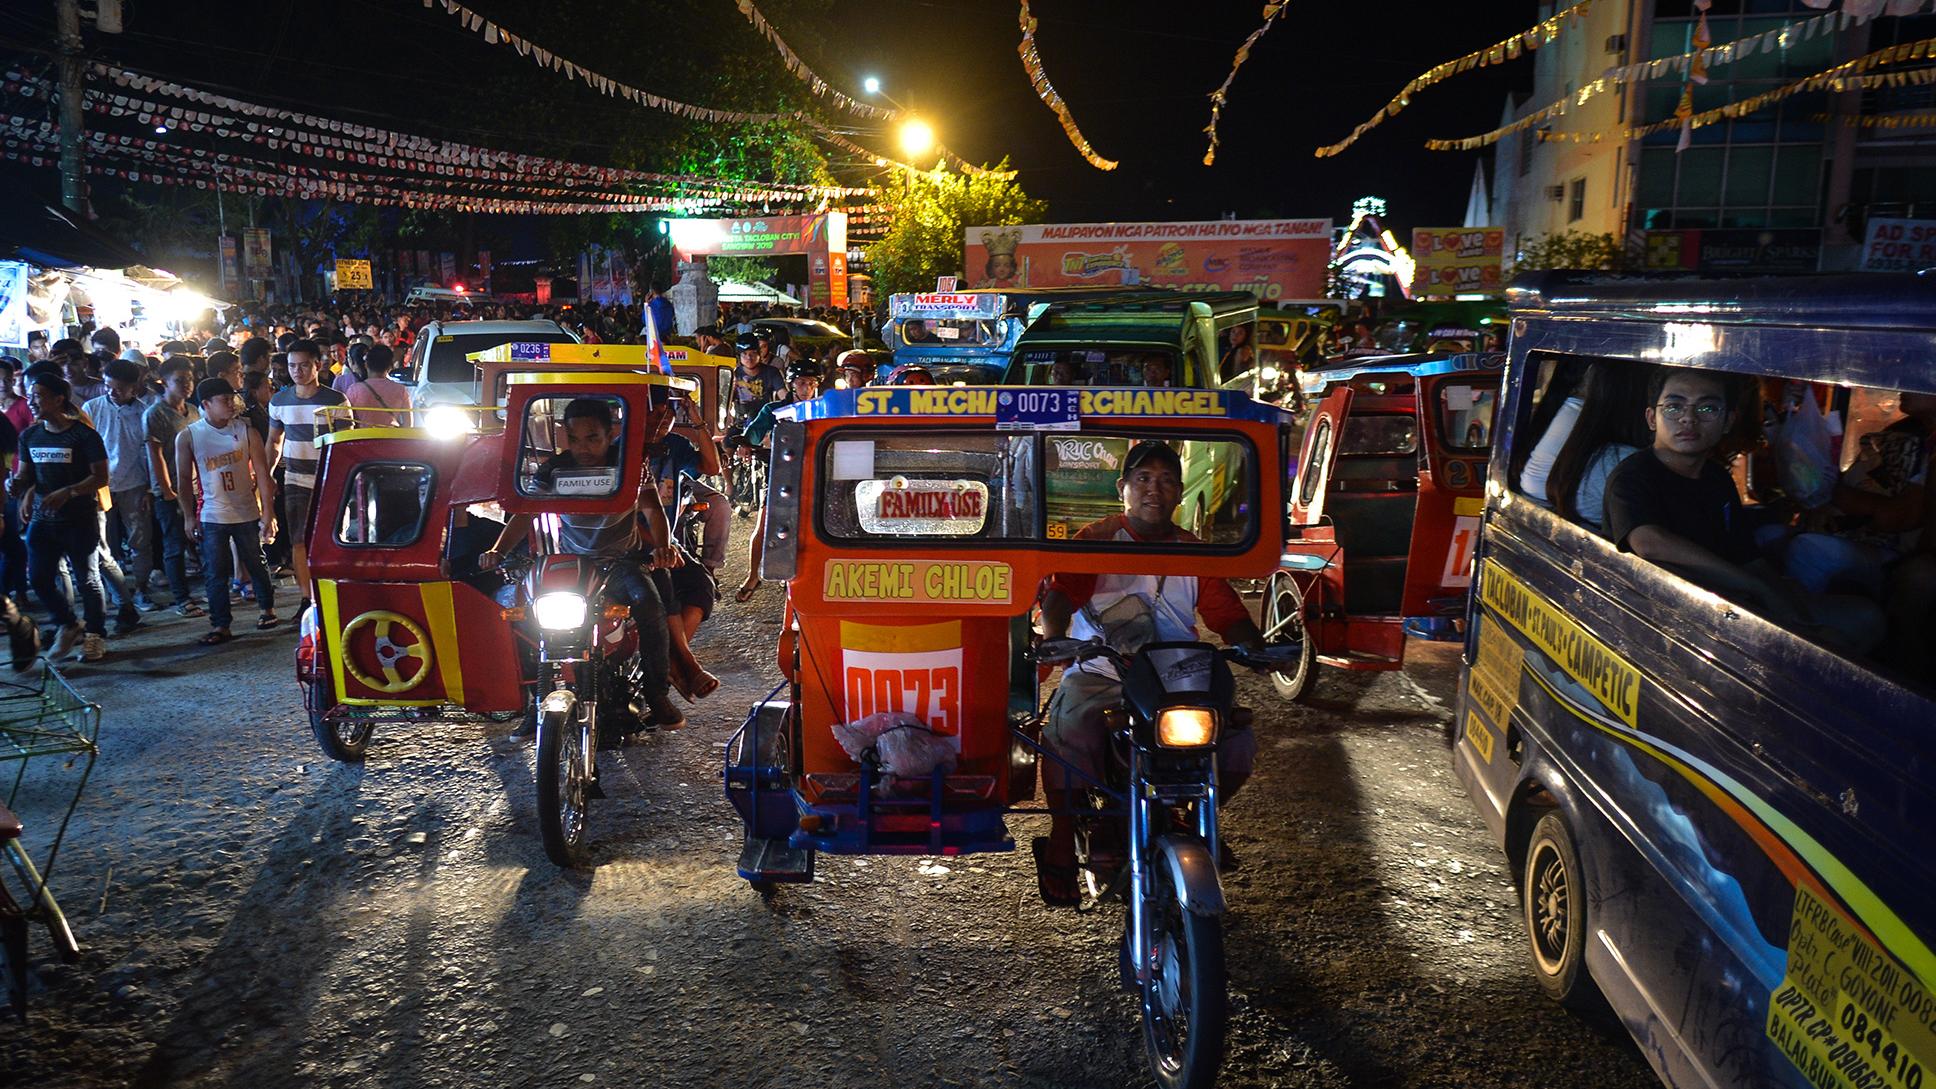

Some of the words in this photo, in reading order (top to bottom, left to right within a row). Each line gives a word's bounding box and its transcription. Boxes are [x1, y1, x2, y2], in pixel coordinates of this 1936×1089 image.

[1042, 226, 1112, 239] MALIPAYON
[1114, 225, 1142, 238] NGA
[1143, 224, 1199, 237] PATRON
[1200, 224, 1217, 236] HA
[1875, 224, 1905, 241] AD
[1870, 242, 1913, 259] FOR
[915, 294, 977, 305] MERLY
[520, 343, 541, 354] 0236
[856, 390, 900, 415] ST.
[1080, 390, 1226, 415] RCHANGEL
[1018, 392, 1060, 413] 0073
[31, 449, 70, 461] Supreme
[220, 471, 236, 492] 13
[558, 479, 591, 489] FAMILY
[593, 478, 611, 488] USE
[879, 490, 948, 518] FAMILY
[953, 490, 982, 517] USE
[1048, 524, 1065, 538] 59
[826, 562, 915, 599] AKEMI
[924, 563, 1010, 600] CHLOE
[846, 666, 960, 737] 0073
